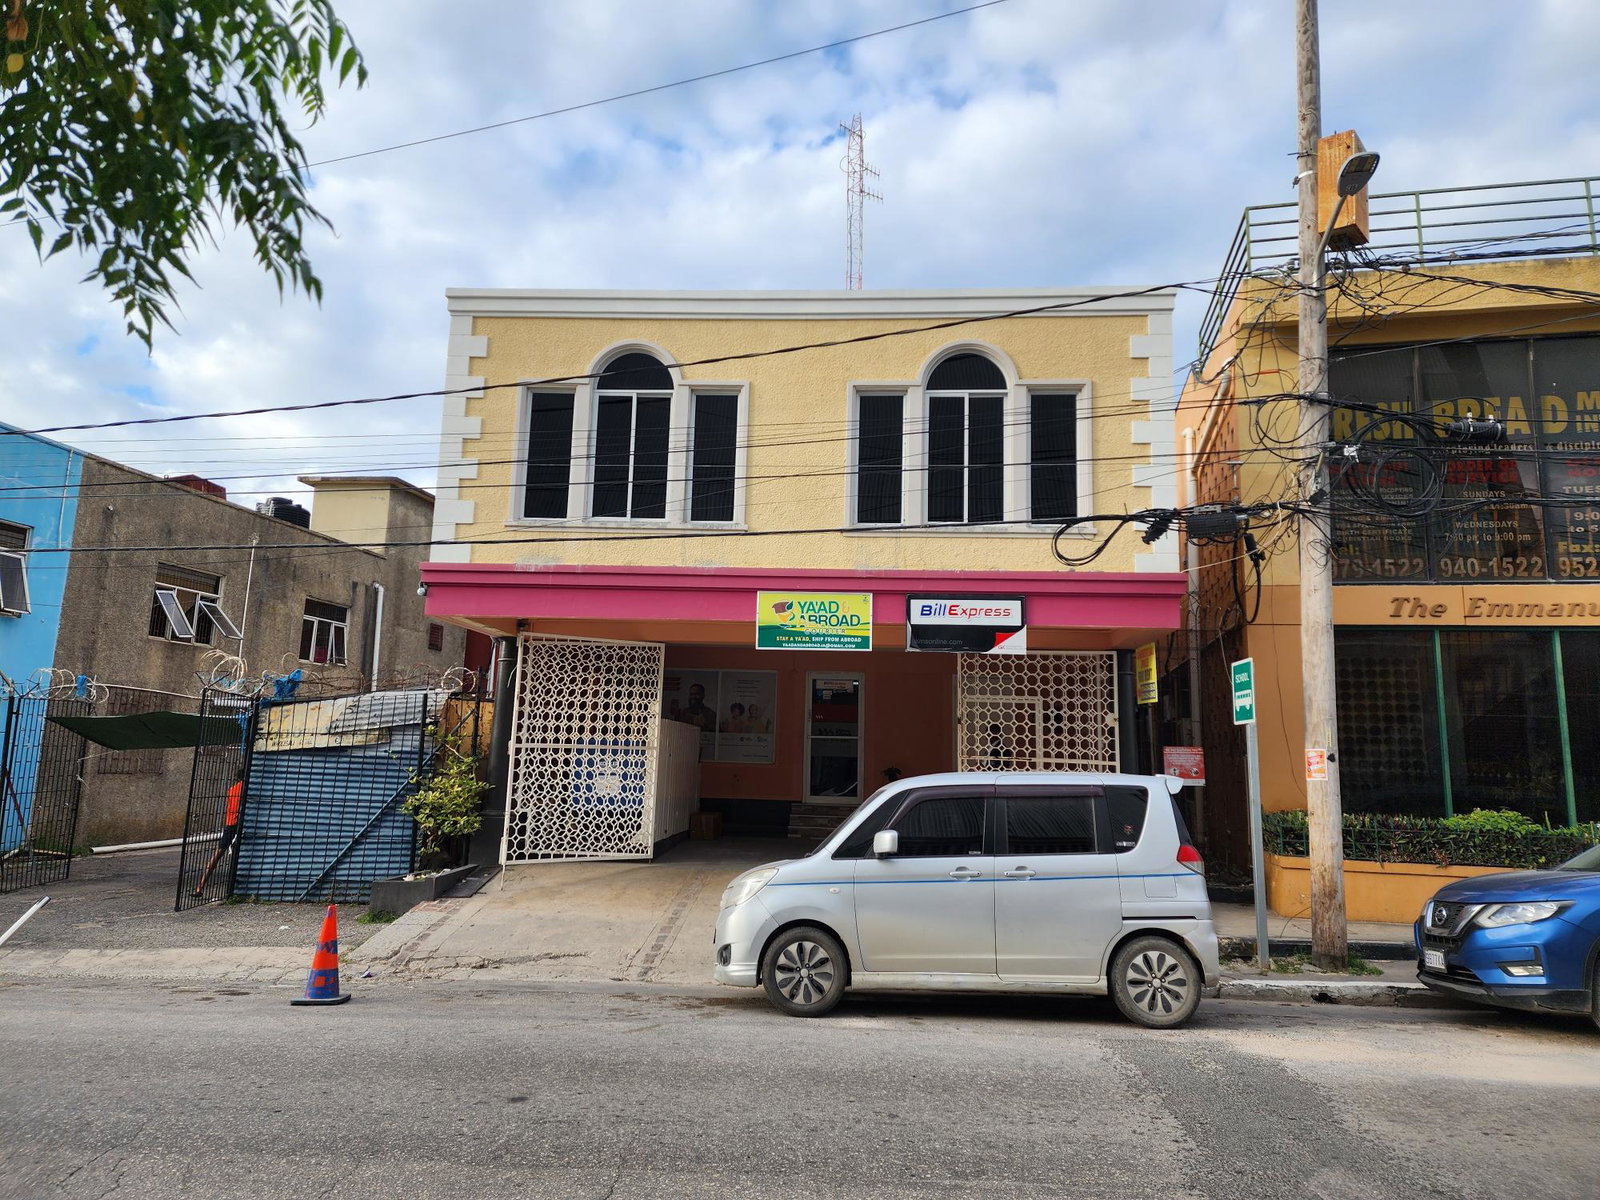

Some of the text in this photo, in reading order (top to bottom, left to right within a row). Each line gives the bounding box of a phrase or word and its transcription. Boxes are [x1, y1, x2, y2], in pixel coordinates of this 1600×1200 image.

[1493, 441, 1534, 452] leaders
[1463, 490, 1506, 499] SUNDAYS
[1455, 520, 1519, 529] WEDNESDAYS
[1483, 532, 1492, 541] to
[1517, 534, 1532, 543] pm
[1557, 541, 1600, 553] Fax:
[1440, 556, 1544, 577] 940-1522
[797, 601, 839, 614] YA'AD
[1389, 596, 1448, 618] The
[798, 614, 861, 627] ABROAD
[1235, 673, 1250, 683] SCHOOL
